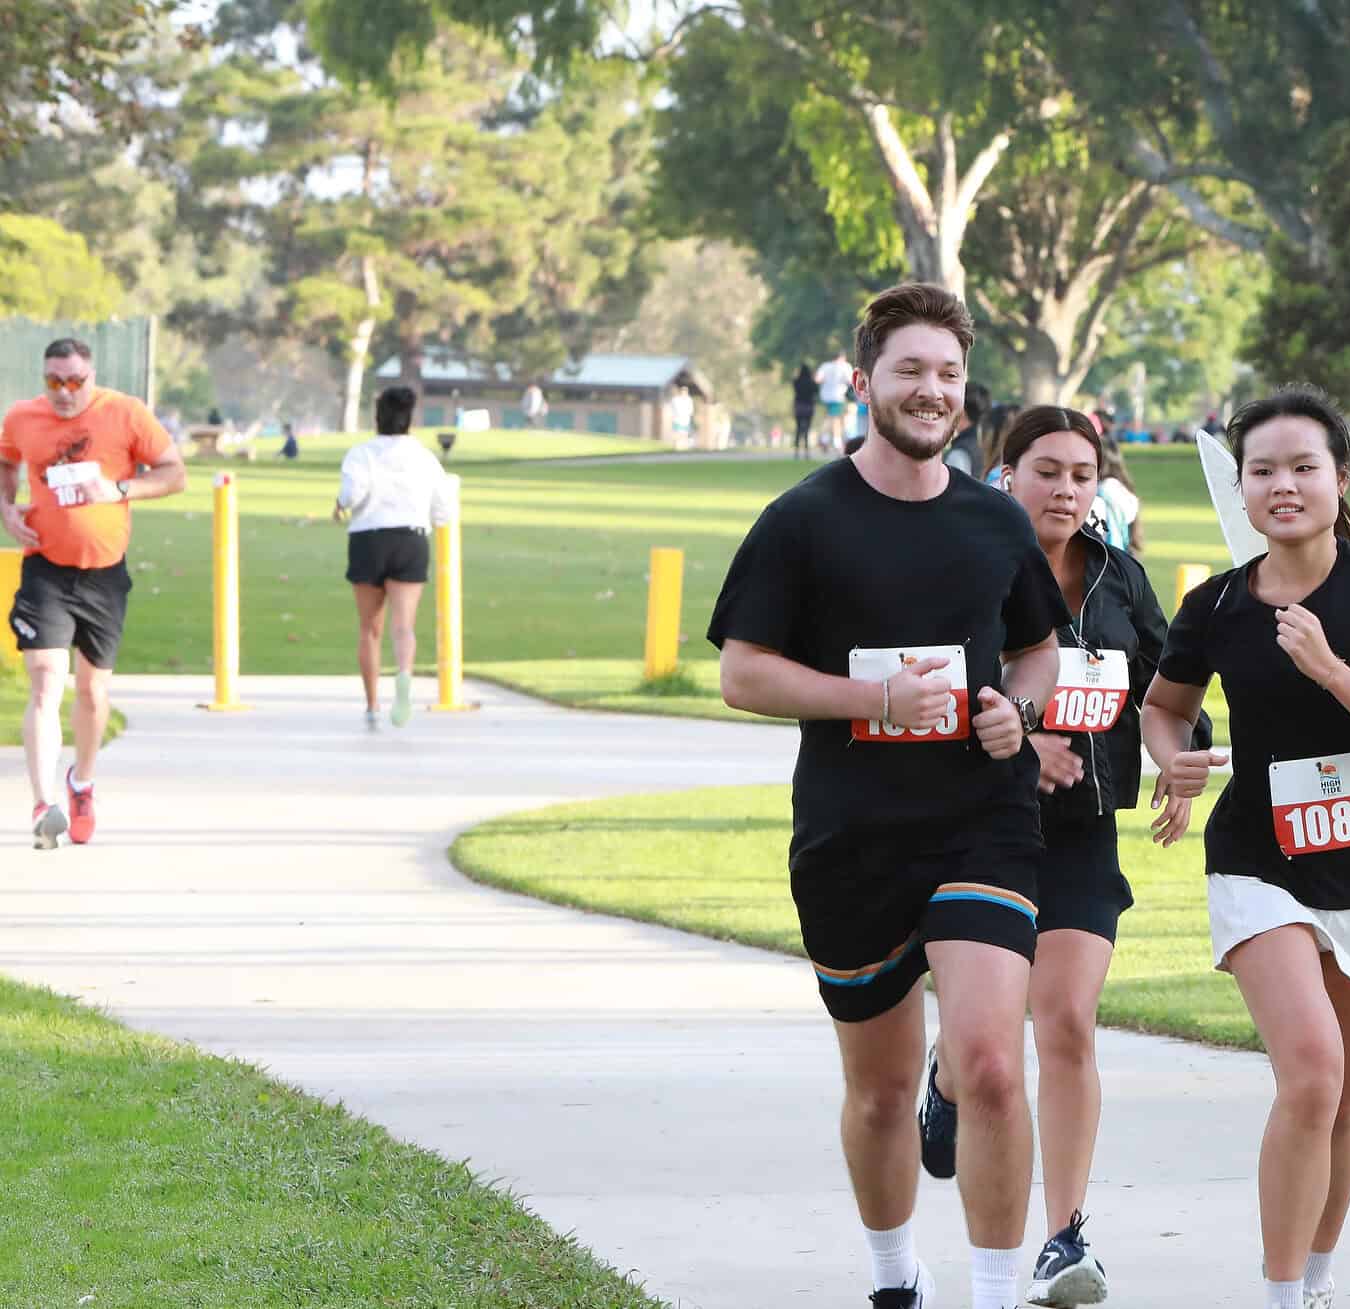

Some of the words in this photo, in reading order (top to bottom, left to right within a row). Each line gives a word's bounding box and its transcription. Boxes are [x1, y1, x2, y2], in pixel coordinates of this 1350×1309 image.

[1054, 689, 1120, 728] 1095
[1320, 780, 1341, 788] HIGH
[1321, 787, 1342, 795] TIDE
